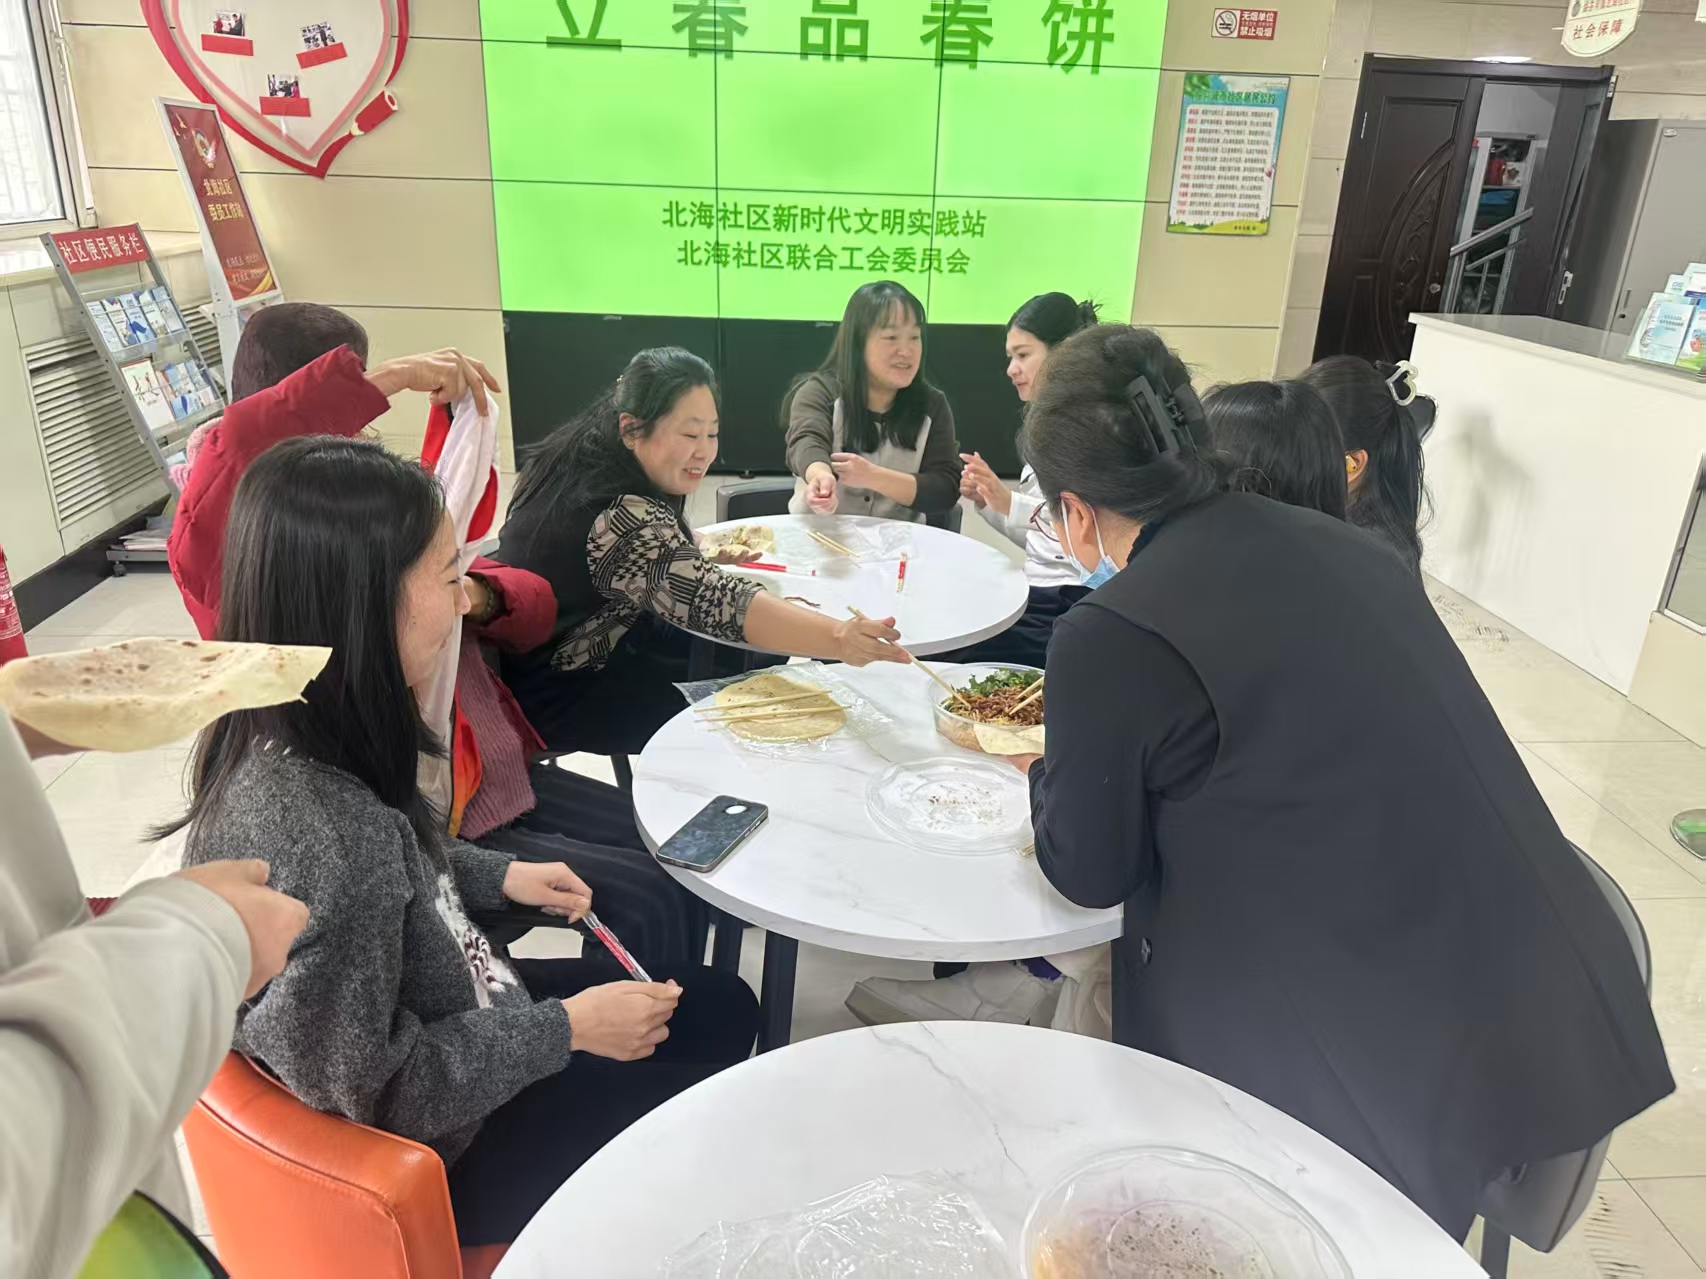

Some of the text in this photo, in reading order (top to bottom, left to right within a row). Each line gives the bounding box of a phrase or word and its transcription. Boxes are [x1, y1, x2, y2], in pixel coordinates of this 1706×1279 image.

[1241, 11, 1275, 22] 无烟单位
[1572, 19, 1623, 40] 社会保障
[662, 200, 987, 238] 北海社区新时代文明实践站
[58, 232, 145, 265] 社区便民服务栏
[677, 240, 971, 275] 北海社区联合工会委员会
